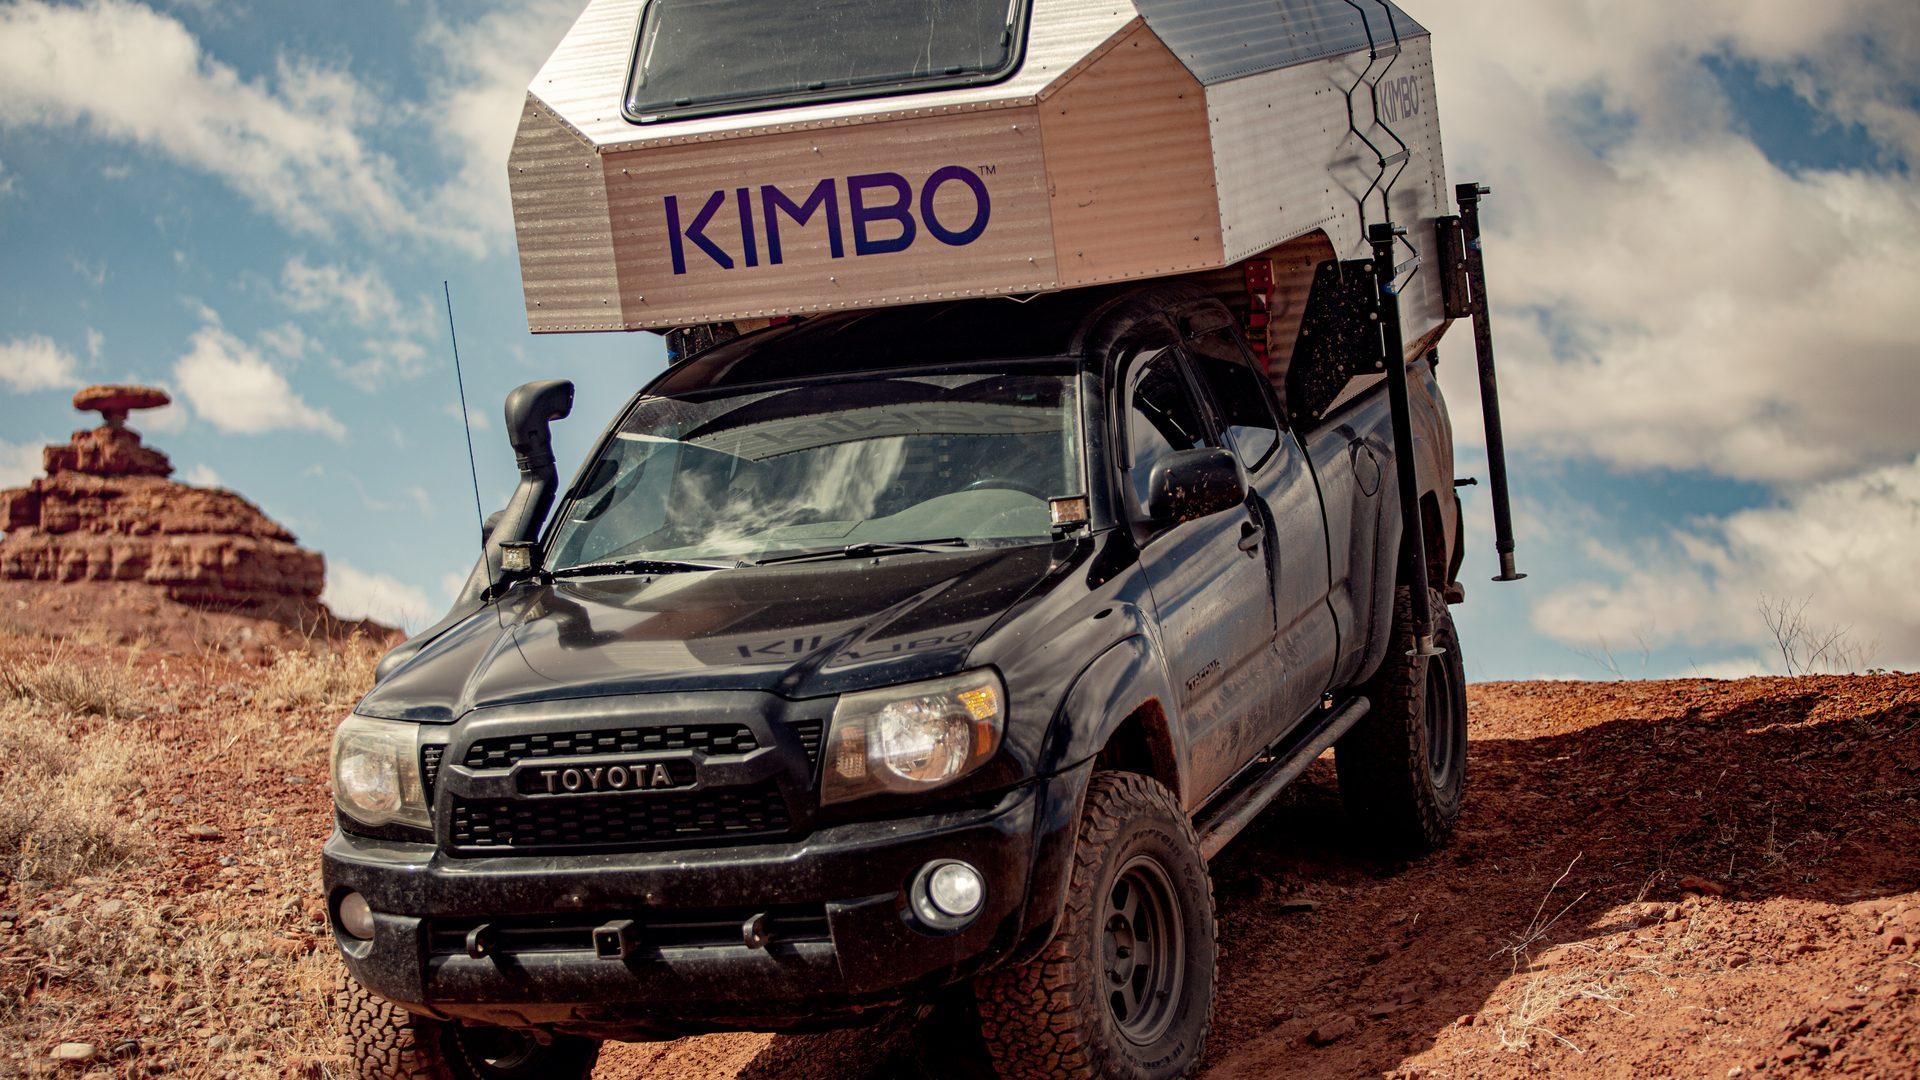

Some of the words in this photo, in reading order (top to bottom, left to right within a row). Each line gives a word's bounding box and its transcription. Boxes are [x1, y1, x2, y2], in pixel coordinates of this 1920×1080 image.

[1379, 75, 1418, 124] KIMBO
[664, 165, 991, 275] KIMBO
[978, 164, 996, 176] TM
[540, 764, 673, 793] TOYOTA
